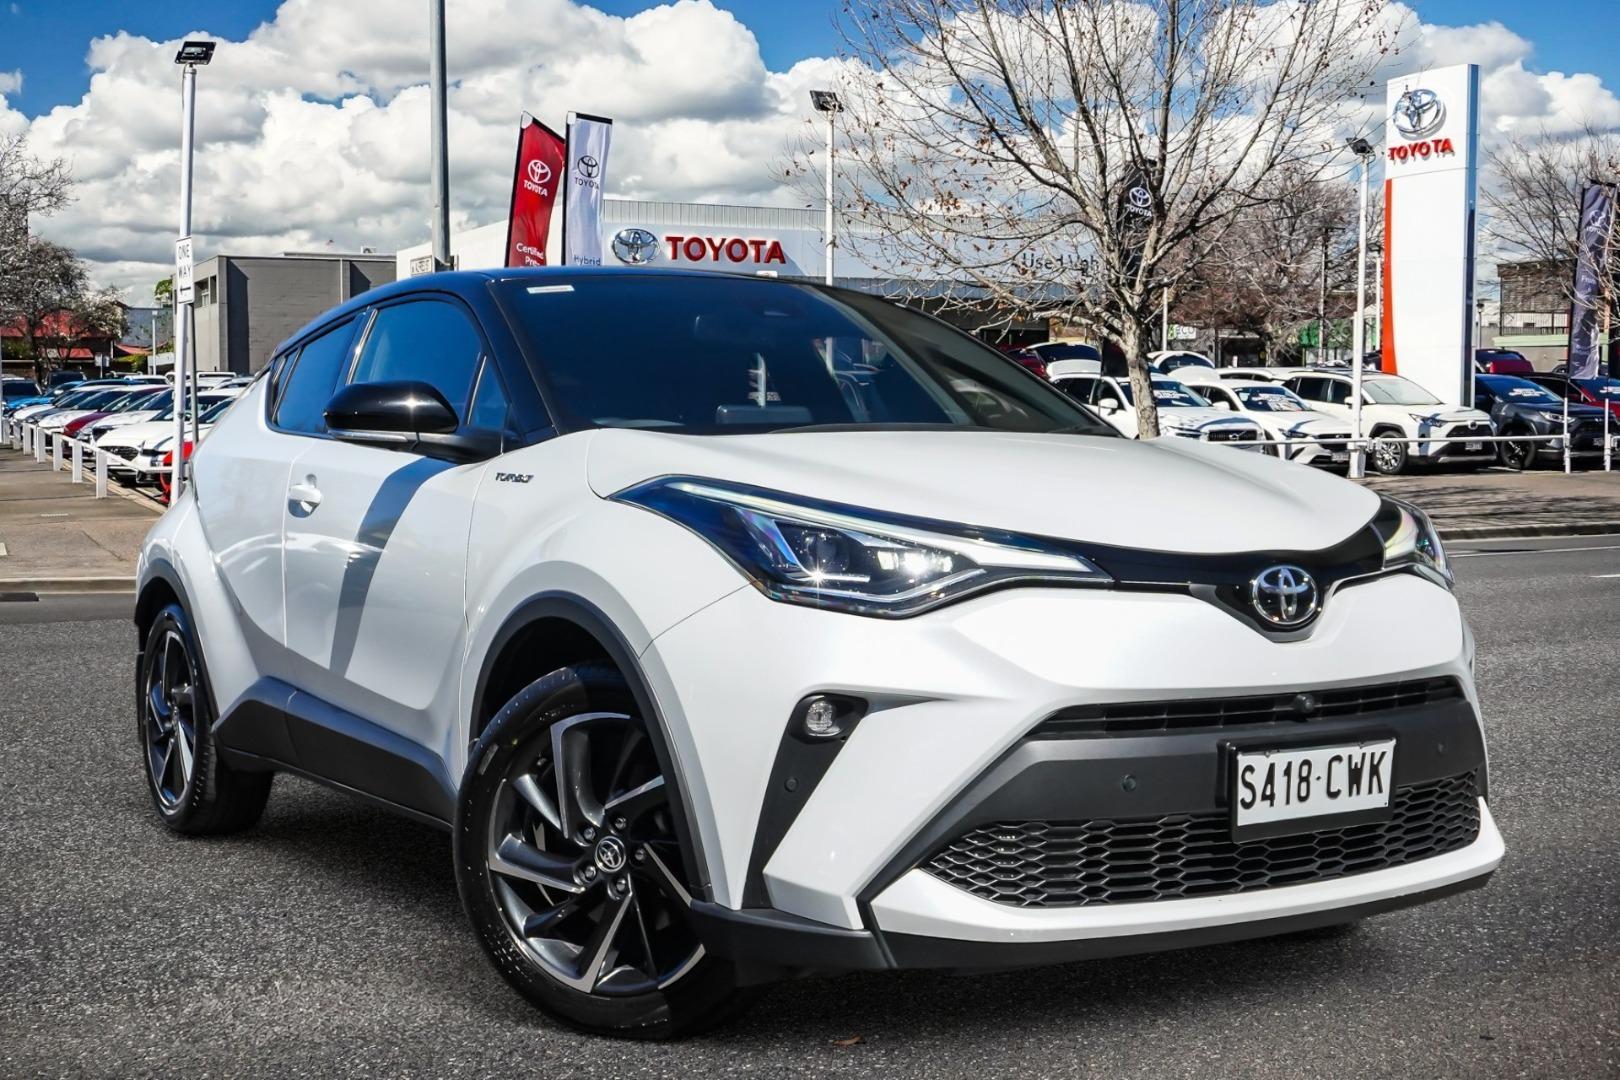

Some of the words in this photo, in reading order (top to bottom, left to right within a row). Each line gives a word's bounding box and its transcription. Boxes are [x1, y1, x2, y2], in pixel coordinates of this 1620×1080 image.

[1388, 138, 1455, 161] TOYOTA
[523, 179, 548, 197] TOYOTA
[178, 244, 190, 260] ONE
[665, 236, 787, 264] TOYOTA
[573, 255, 601, 266] Hybrid
[178, 264, 191, 279] WAY
